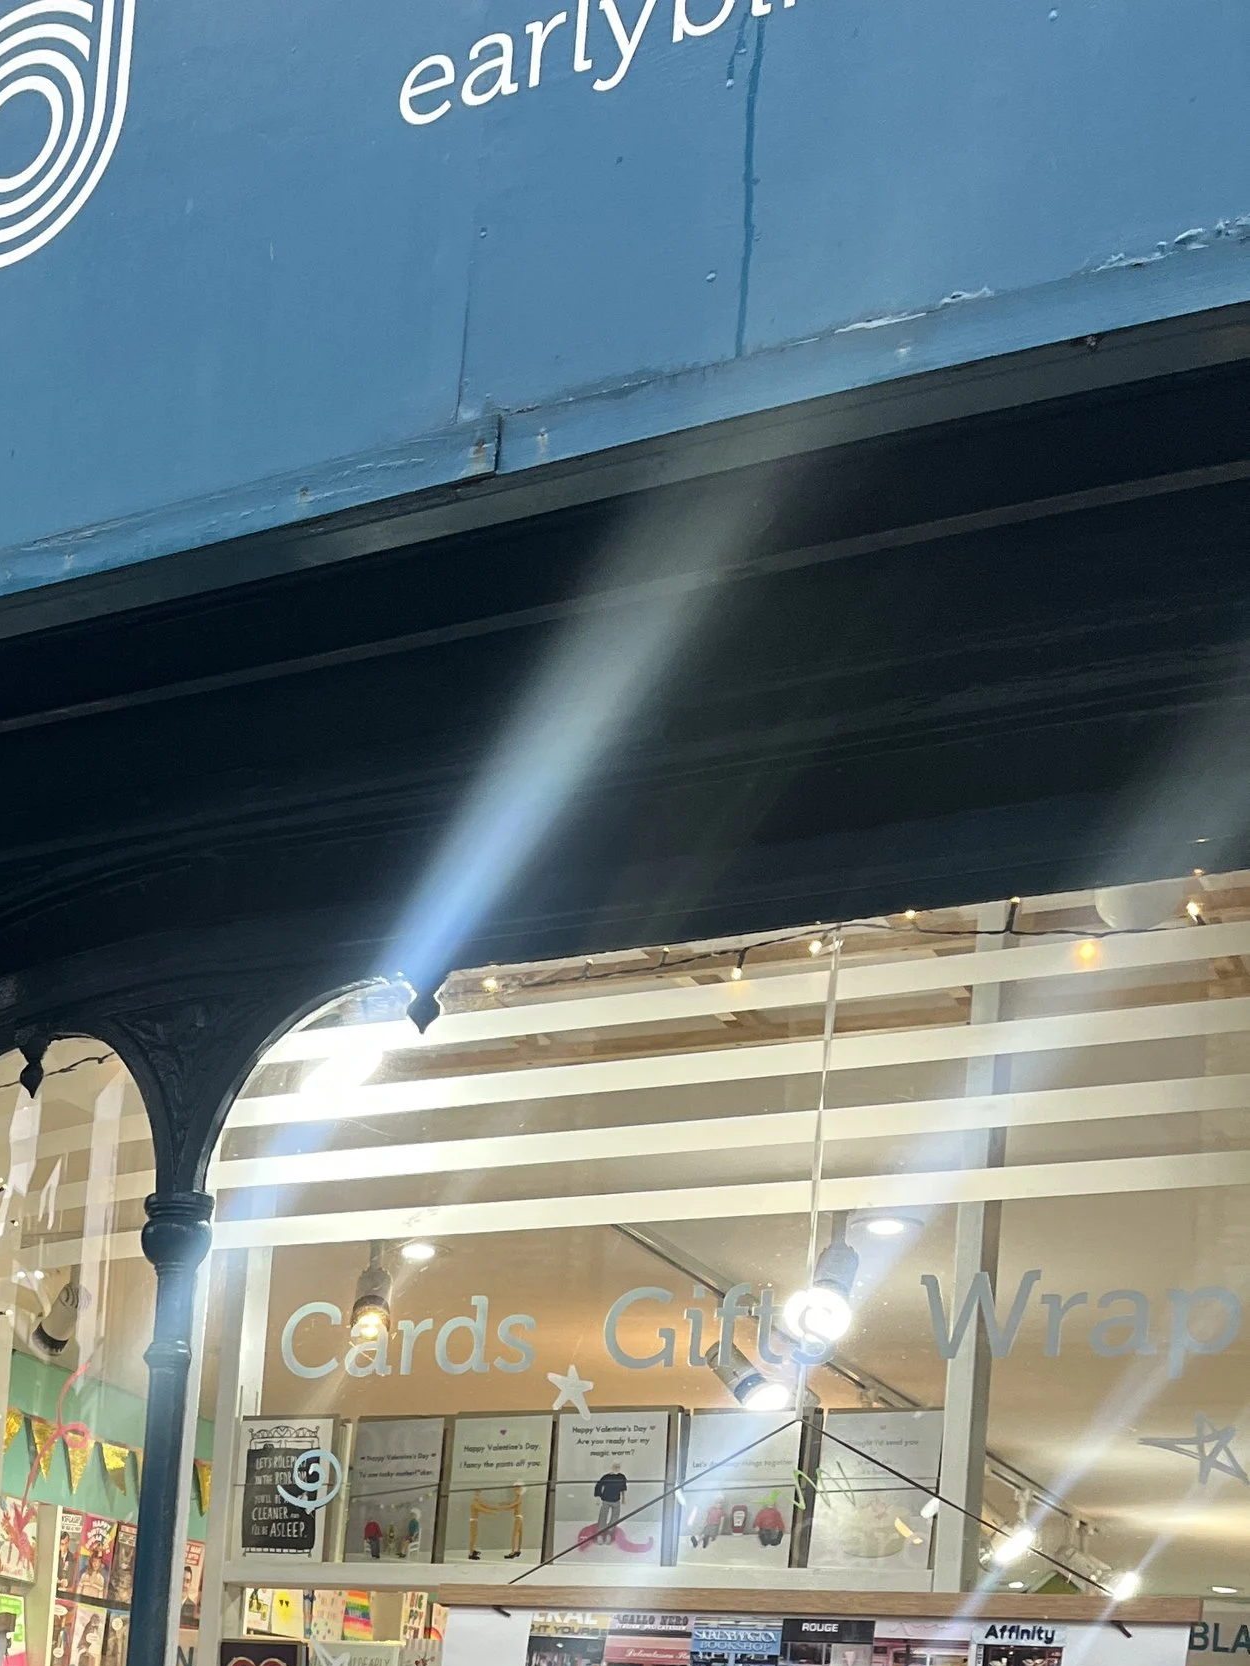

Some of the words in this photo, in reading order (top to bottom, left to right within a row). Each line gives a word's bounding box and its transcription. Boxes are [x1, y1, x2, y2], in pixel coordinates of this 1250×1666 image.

[281, 1295, 536, 1382] Cards
[602, 1282, 836, 1372] Gifts
[920, 1268, 1244, 1380] Wrap
[572, 1426, 593, 1434] Happy
[634, 1425, 647, 1433] Day
[605, 1437, 625, 1446] ready
[463, 1461, 481, 1469] fancy
[252, 1507, 288, 1520] CLEANER
[802, 1622, 838, 1633] ROUGE
[984, 1624, 1056, 1644] Affinity
